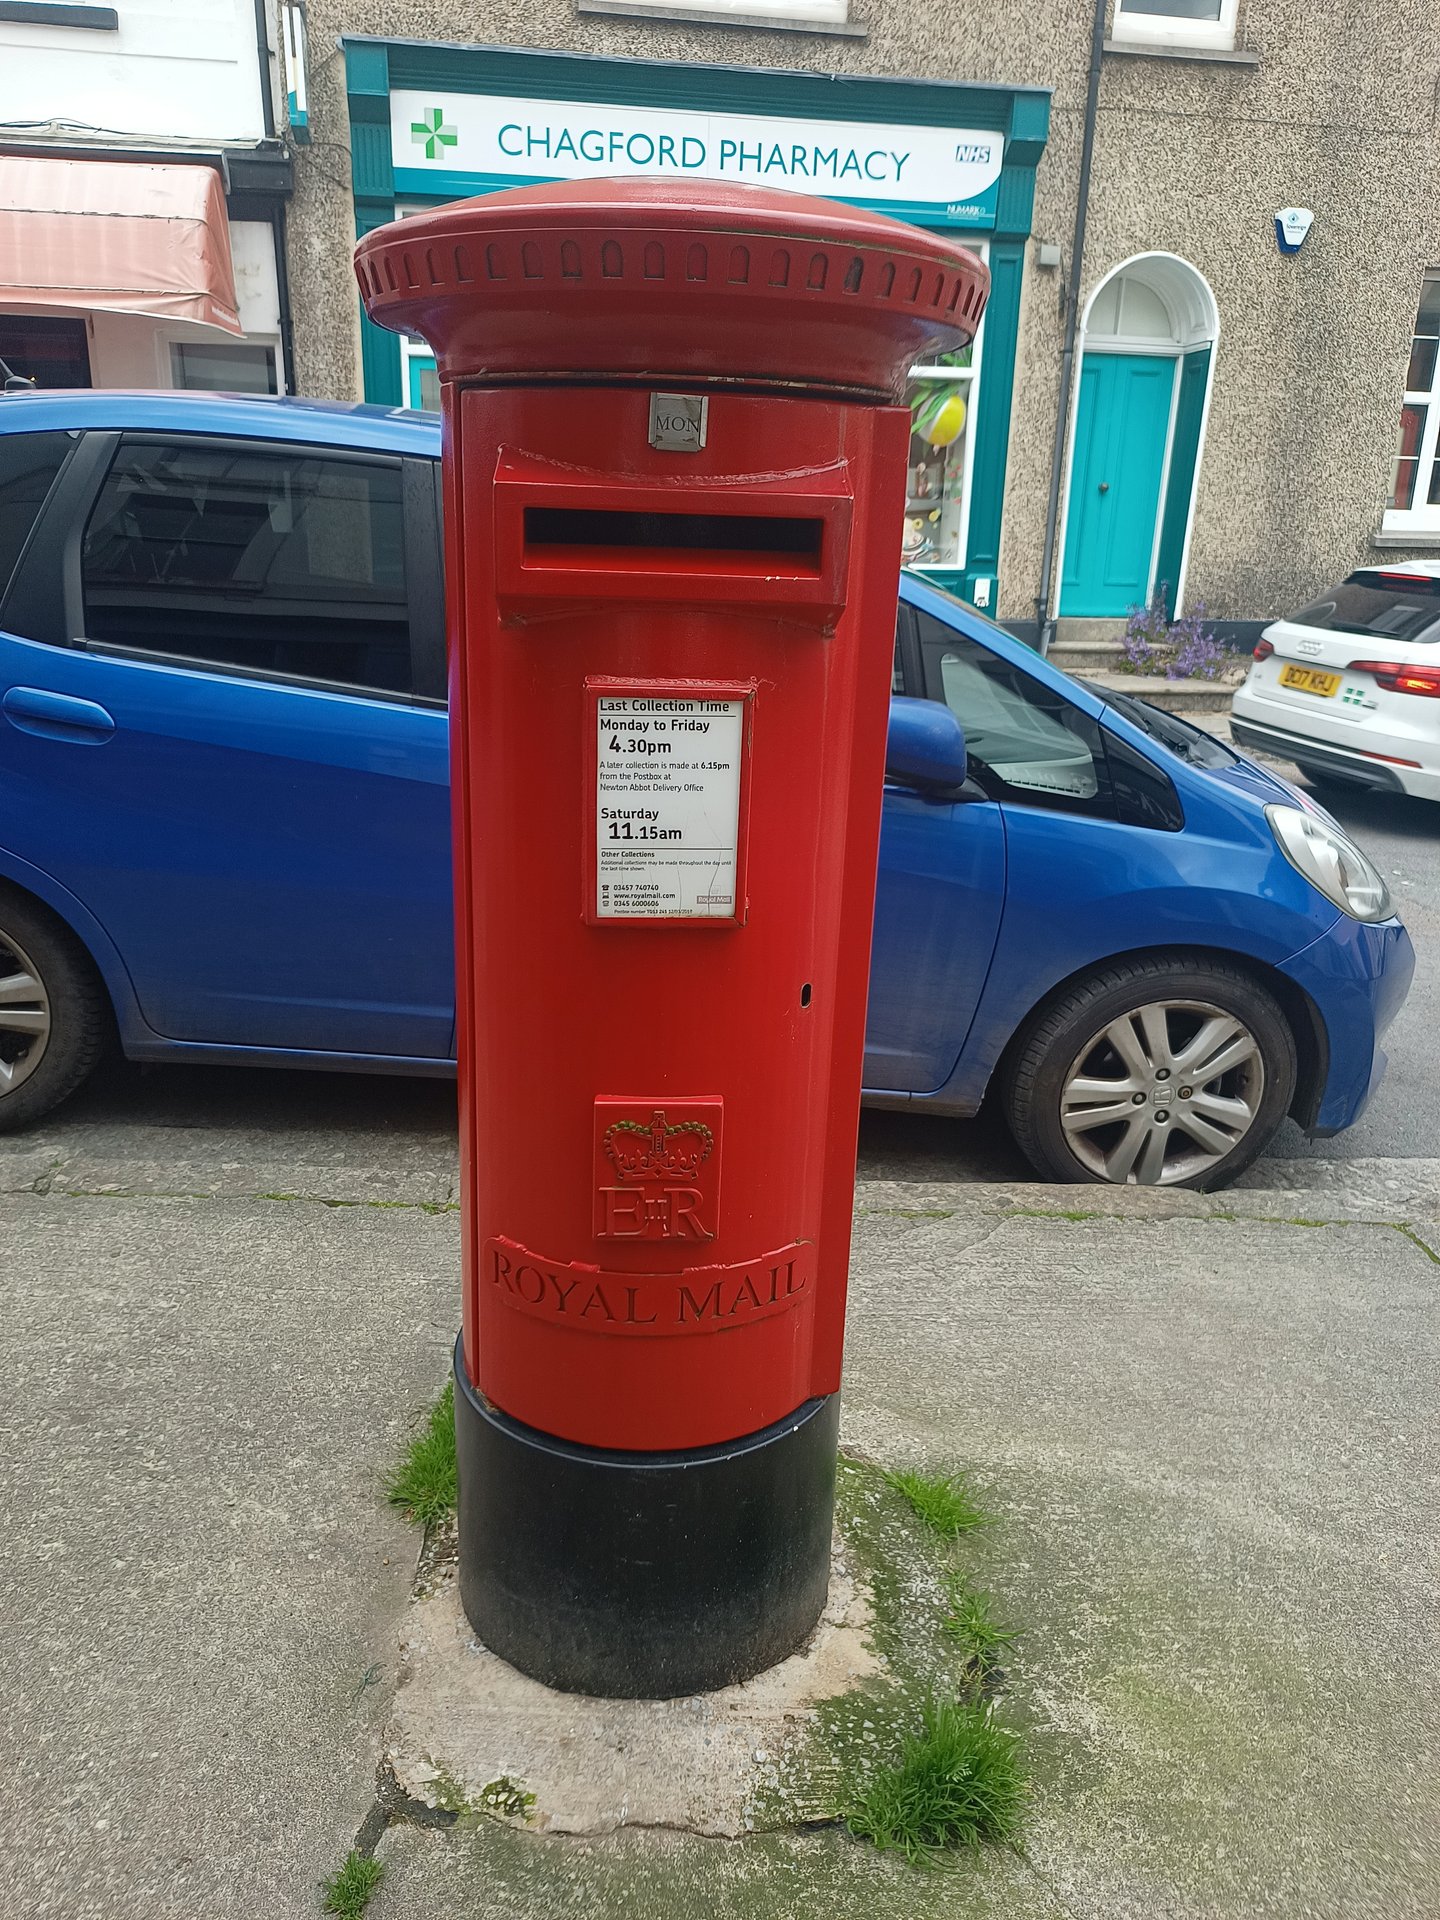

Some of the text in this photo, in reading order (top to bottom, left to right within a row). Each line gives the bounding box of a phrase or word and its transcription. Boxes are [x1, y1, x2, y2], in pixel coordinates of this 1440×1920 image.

[498, 124, 911, 182] CHAGFORD PHARMACY
[956, 145, 990, 162] NHS
[656, 415, 700, 432] MON
[600, 699, 730, 712] Last Collection Time
[600, 719, 710, 734] Monday to Friday
[609, 734, 672, 756] 4.30pm
[600, 761, 605, 769] A
[607, 761, 623, 769] later
[625, 761, 659, 769] collection
[669, 762, 690, 770] made
[700, 762, 730, 771] 6.15pm
[600, 772, 672, 781] from the Postbox at
[600, 783, 704, 793] Newton Abbot Delivery Office
[600, 807, 659, 821] Saturday
[608, 822, 682, 839] 11.15am
[613, 892, 676, 900] www.royalmail.com
[492, 1250, 807, 1323] ROYAL MAIL
